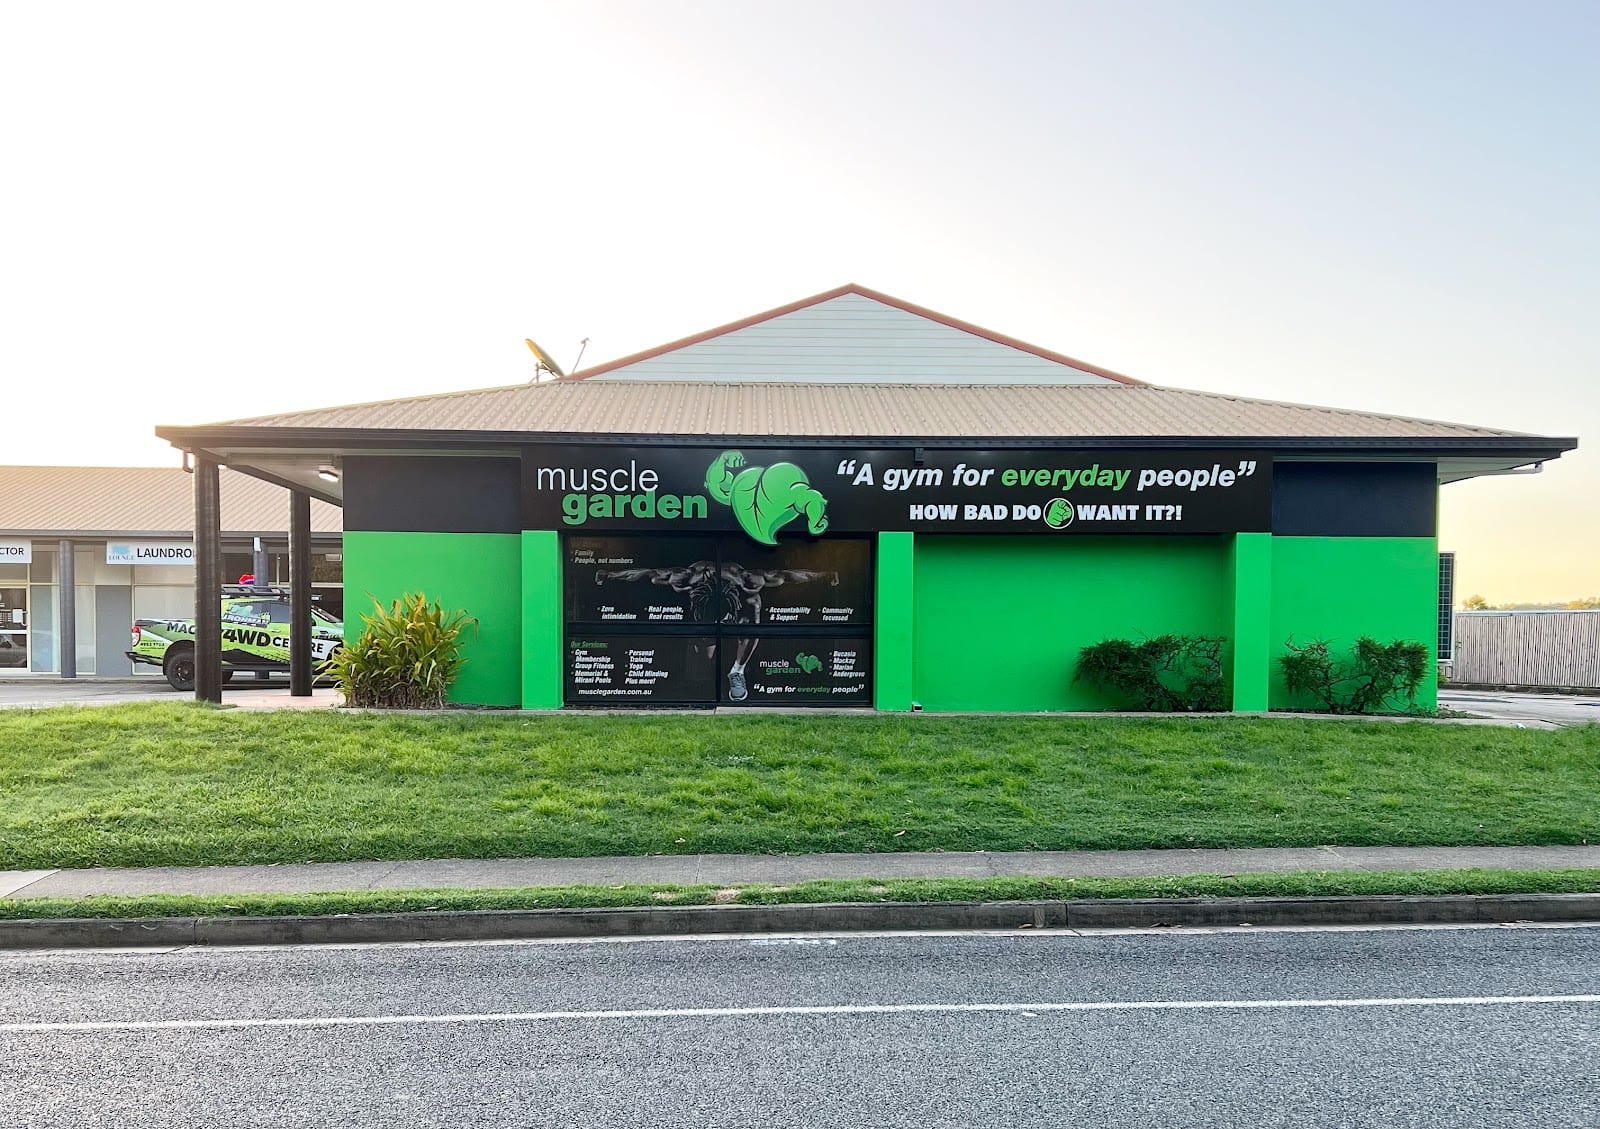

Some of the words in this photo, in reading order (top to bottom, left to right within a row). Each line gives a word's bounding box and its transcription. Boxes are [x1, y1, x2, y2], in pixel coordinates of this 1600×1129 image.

[537, 460, 659, 491] muscle
[837, 460, 875, 487] “A
[883, 468, 943, 491] gym
[952, 464, 995, 487] for
[1001, 464, 1130, 491] everyday
[1137, 460, 1257, 491] people”
[562, 490, 708, 525] garden
[909, 504, 962, 521] HOW
[964, 504, 1009, 521] BAD
[1012, 504, 1041, 521] DO
[1077, 504, 1139, 521] WANT
[1145, 504, 1182, 521] IT?!
[137, 547, 195, 558] LAUNDRO
[662, 605, 684, 613] people,
[769, 606, 811, 615] Accountability
[822, 607, 853, 615] Community
[223, 629, 271, 647] 4WD
[272, 636, 323, 654] CERE
[570, 640, 581, 648] Our
[574, 649, 588, 657] Gym
[630, 656, 653, 664] Training
[759, 659, 790, 668] muscle
[644, 670, 669, 678] Minding
[765, 666, 801, 675] garden
[578, 688, 652, 696] musclegarden.com.au
[766, 686, 783, 694] gym
[784, 685, 796, 693] for
[797, 685, 830, 694] everyday
